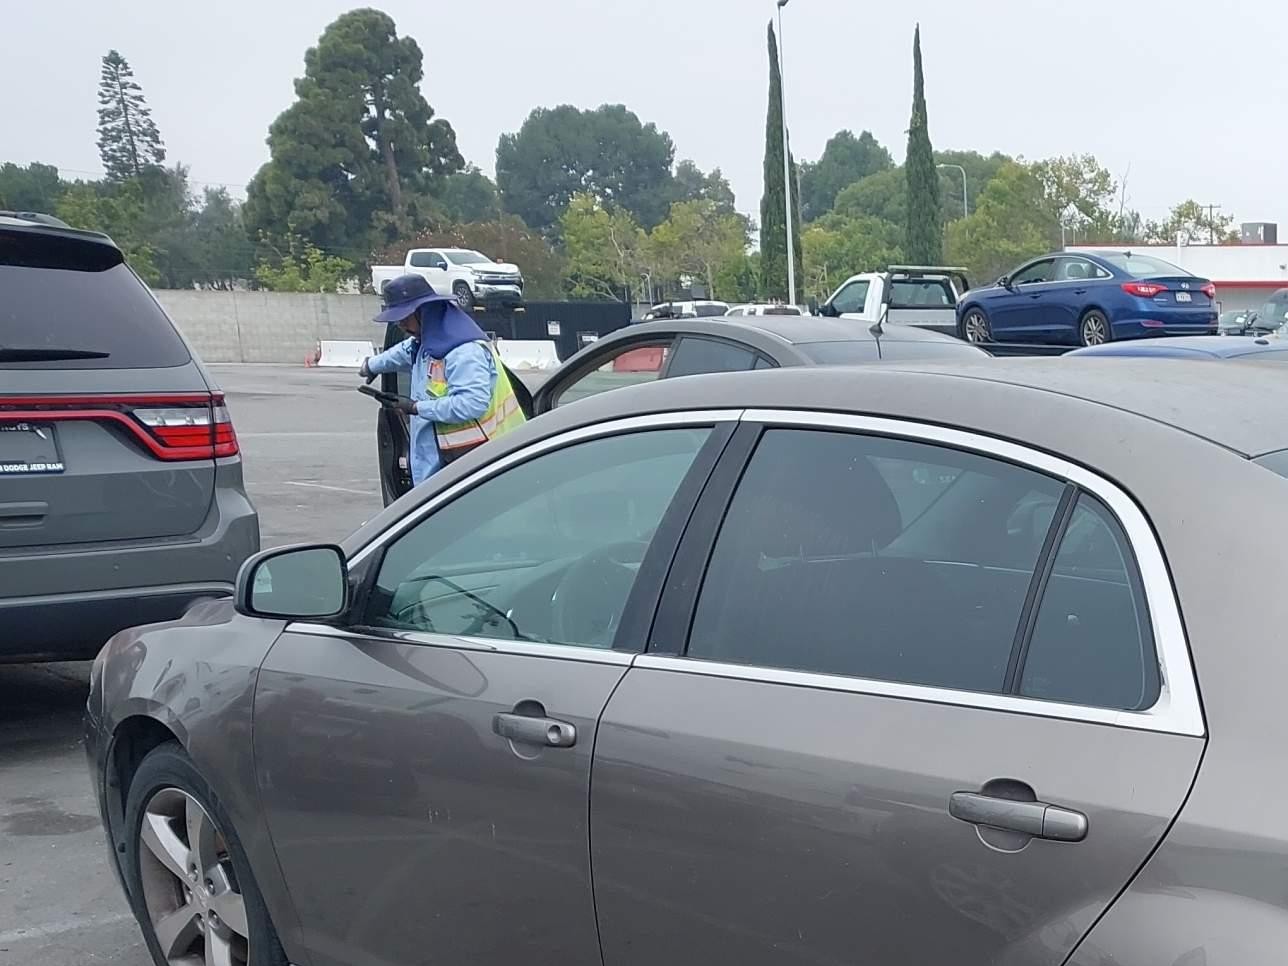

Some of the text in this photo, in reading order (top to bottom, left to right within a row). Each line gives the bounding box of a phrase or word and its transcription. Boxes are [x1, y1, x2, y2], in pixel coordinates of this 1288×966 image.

[3, 464, 29, 472] DODGE
[30, 463, 46, 471] JEEP
[46, 462, 64, 470] RAM
